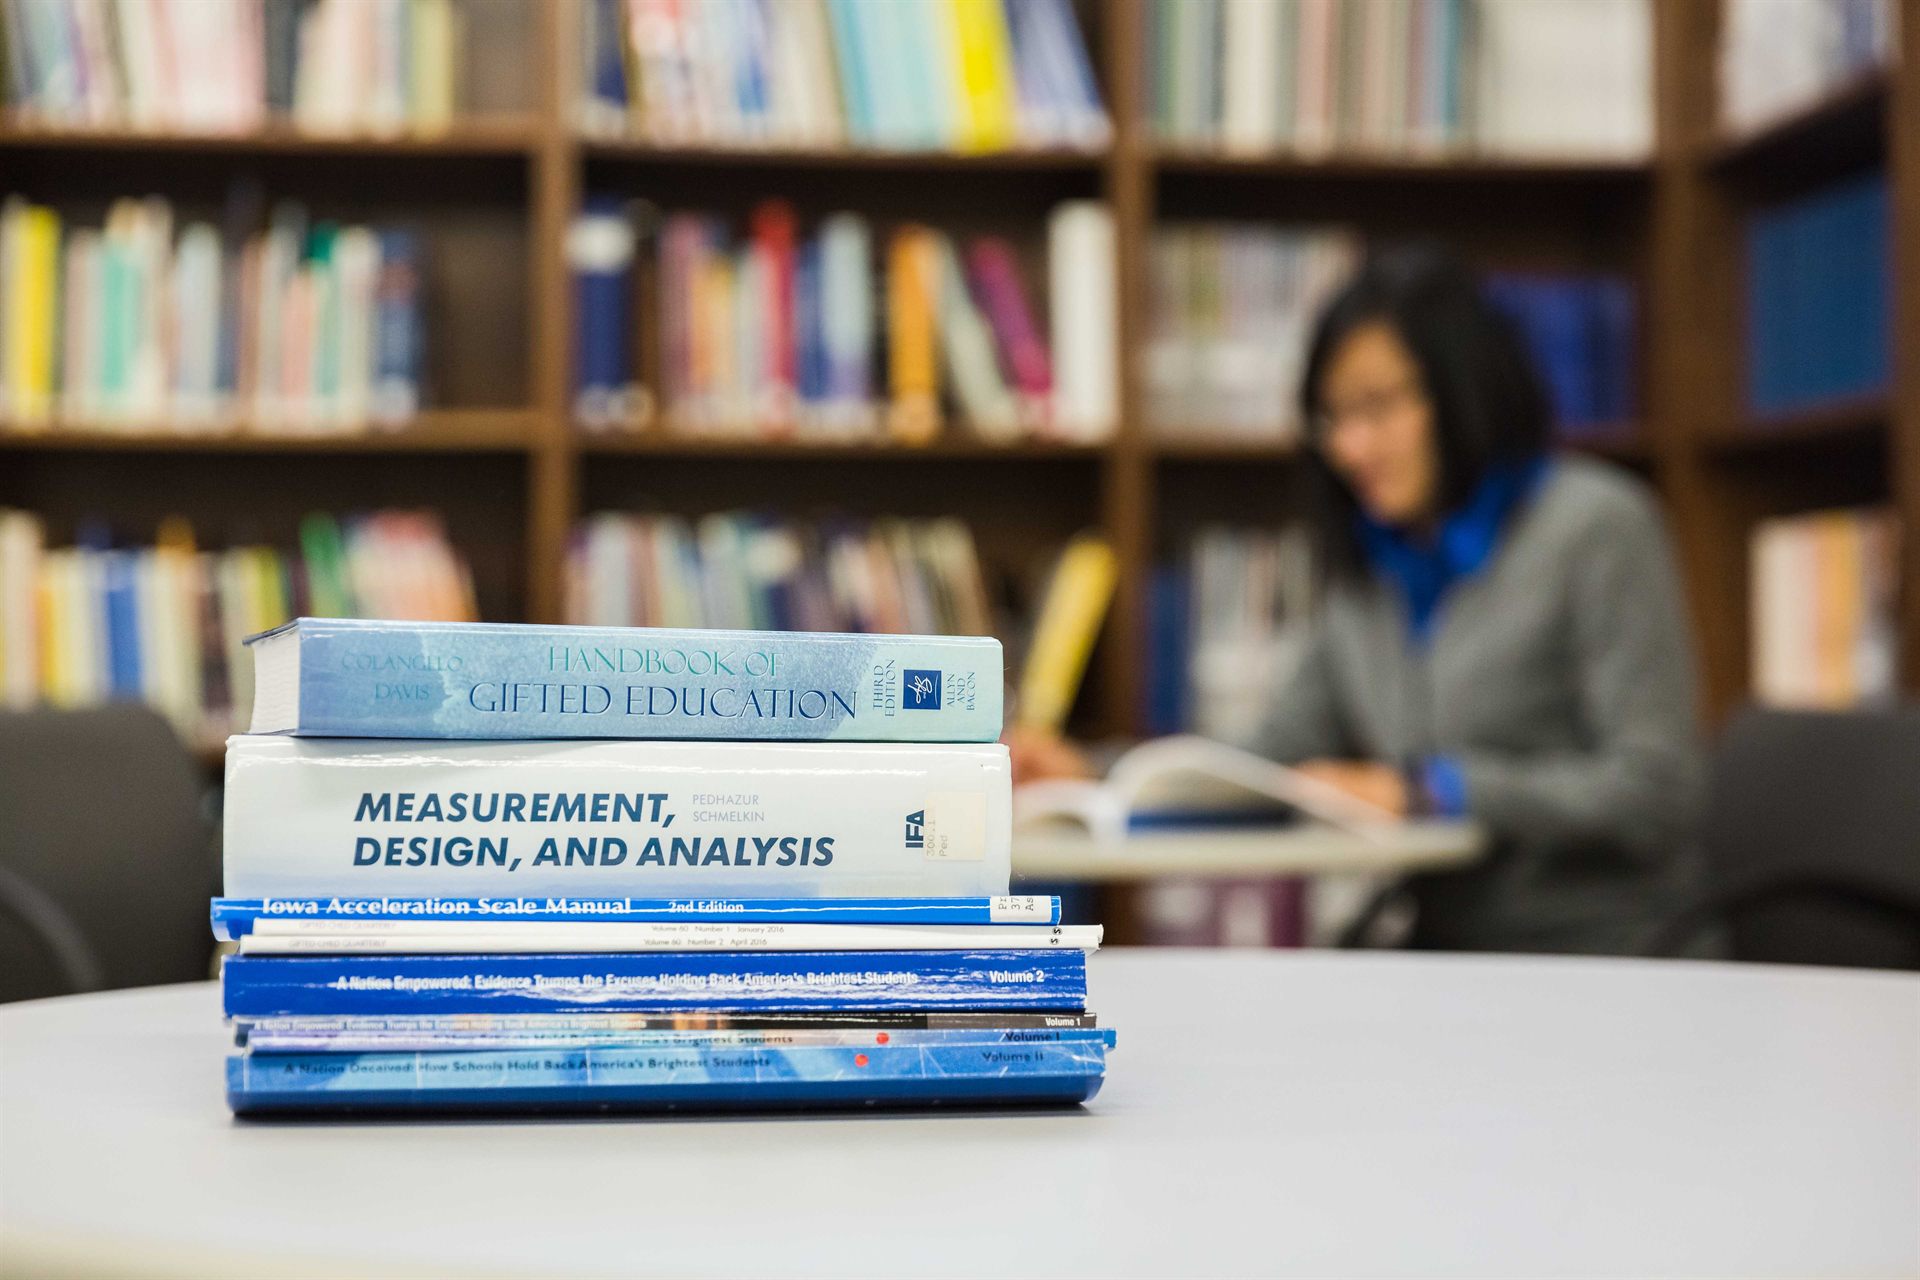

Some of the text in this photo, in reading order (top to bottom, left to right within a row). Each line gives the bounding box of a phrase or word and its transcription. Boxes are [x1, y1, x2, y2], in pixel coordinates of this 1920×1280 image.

[341, 653, 464, 673] COLANGELO
[548, 645, 785, 677] HANDBOOK OF
[375, 683, 430, 700] DAVIS
[872, 664, 884, 710] THIRD
[884, 658, 896, 717] EDITION
[946, 673, 956, 708] ALLYN
[956, 677, 966, 704] AND
[966, 671, 976, 711] BACON
[469, 682, 857, 720] GIFTED EDUCATION
[692, 793, 760, 806] PEDHAZUR
[354, 792, 676, 828] MEASUREMENT,
[692, 810, 765, 823] SCHMELKIN
[353, 837, 836, 872] DESIGN, AND ANALYSIS
[262, 897, 631, 915] Iowa Acceleration Scale Manual
[668, 901, 744, 914] 2nd Edition
[652, 925, 677, 933] Volume
[694, 925, 723, 933] Number
[737, 925, 765, 935] January
[767, 926, 785, 934] 2016
[644, 938, 669, 946] Volume
[687, 938, 716, 946] Number
[730, 938, 748, 947] April
[750, 938, 768, 946] 2016
[336, 971, 919, 992] A Nation Empowered: Evidence Trumps the Excuses Holding Back America's Brightest Students
[989, 970, 1045, 983] Volume 2
[1045, 1017, 1075, 1026] Volume
[1005, 1031, 1051, 1042] Volume
[284, 1064, 295, 1074] A
[299, 1063, 345, 1074] Nation
[419, 1062, 448, 1073] How
[452, 1061, 502, 1072] Schools
[507, 1059, 539, 1071] Hold
[544, 1059, 573, 1070] Back
[579, 1059, 644, 1070] America's
[648, 1057, 708, 1072] Brightest
[712, 1056, 770, 1068] Students
[982, 1051, 1030, 1063] Volume
